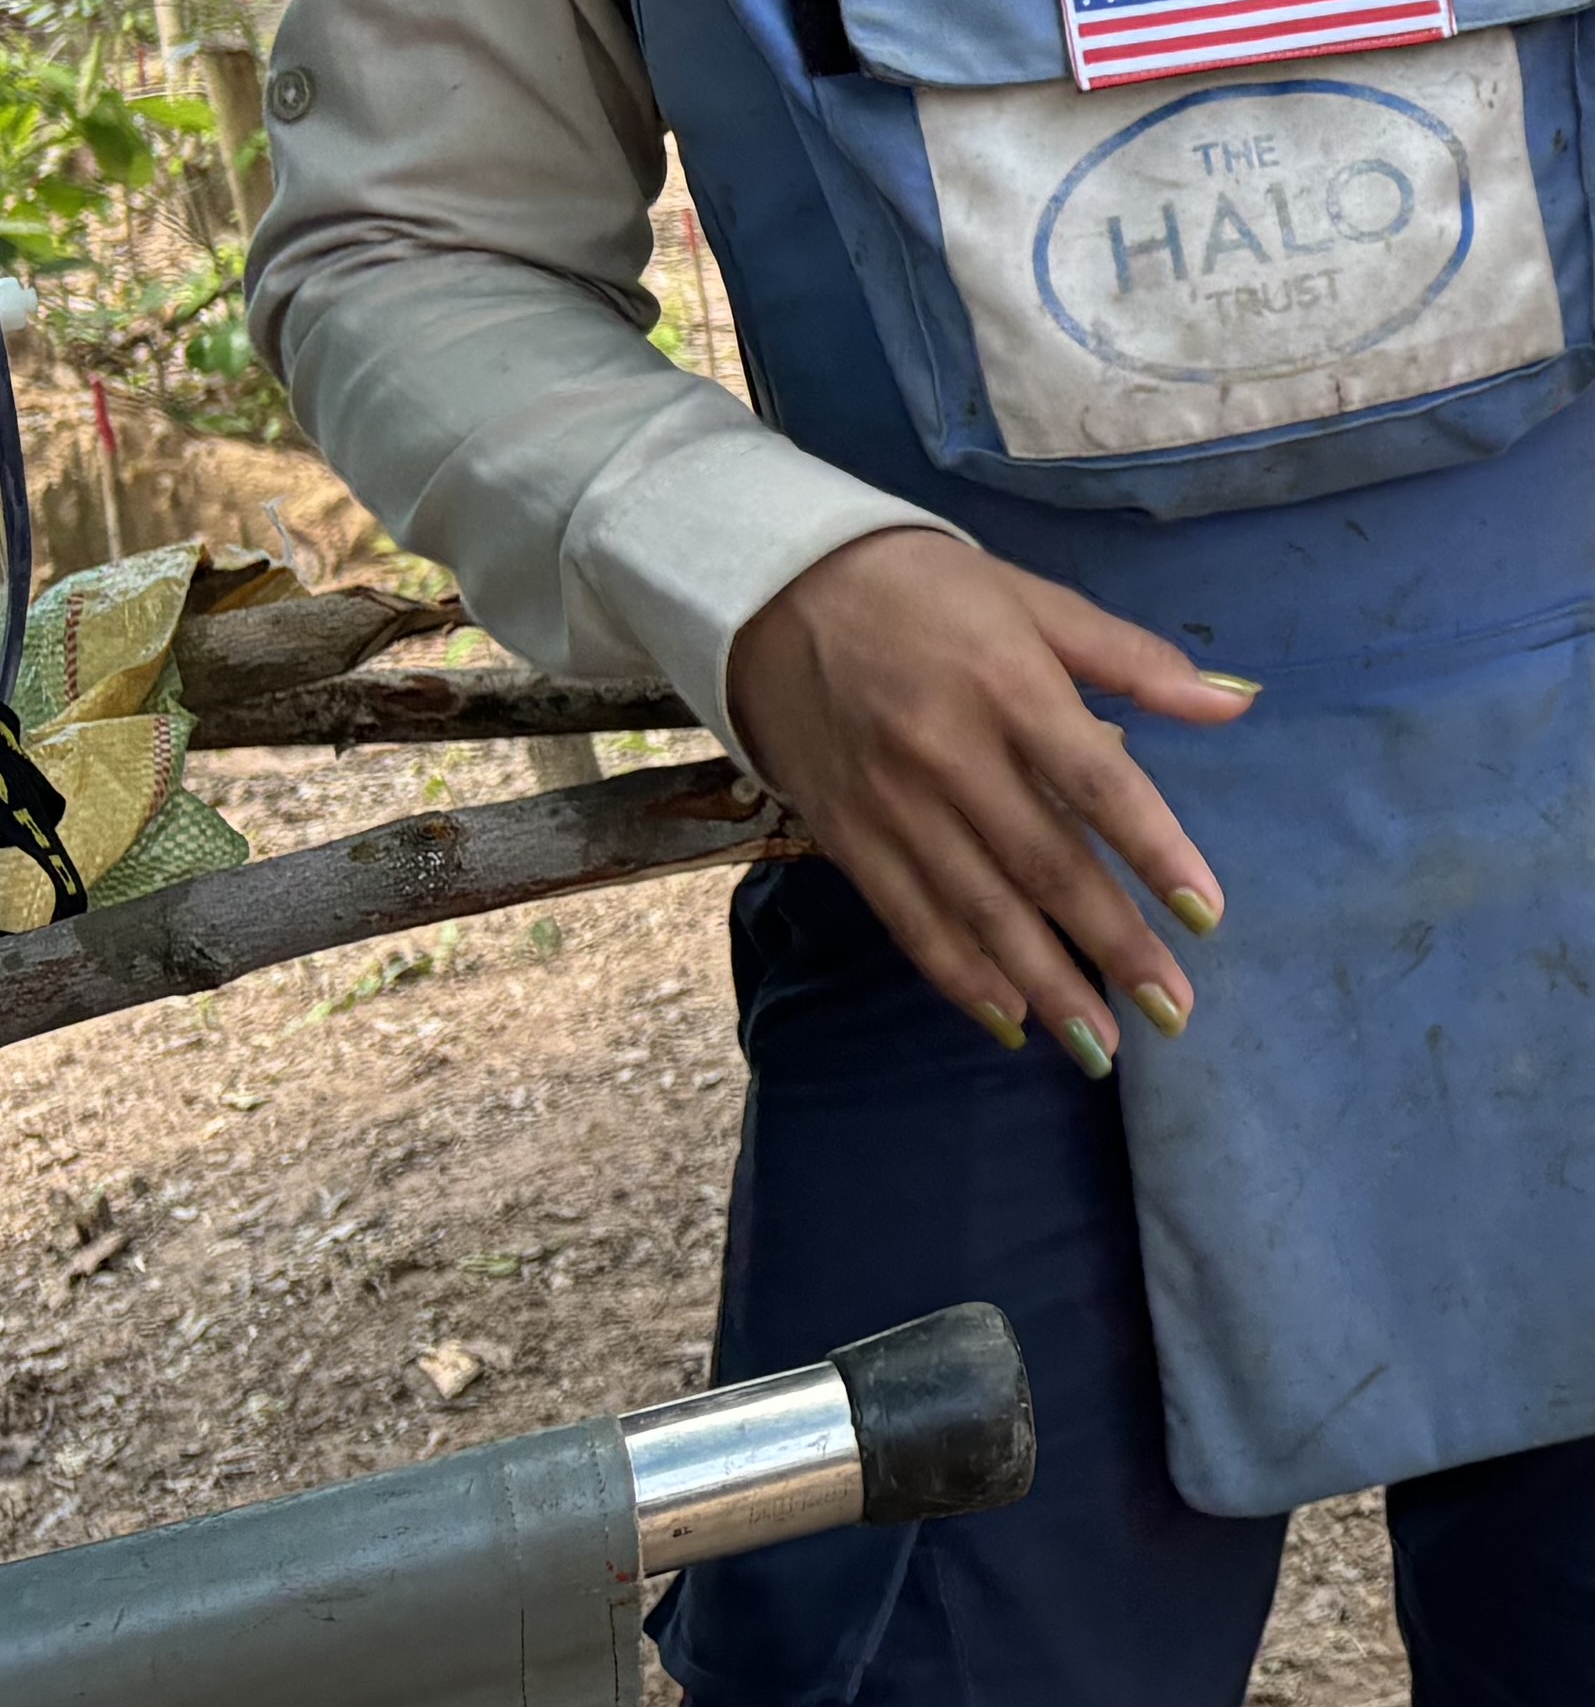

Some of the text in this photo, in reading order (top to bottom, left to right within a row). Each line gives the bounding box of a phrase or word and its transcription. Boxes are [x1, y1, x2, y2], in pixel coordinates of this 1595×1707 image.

[1192, 132, 1281, 177] THE
[1106, 157, 1416, 295] HALO
[1206, 267, 1346, 330] TRUST
